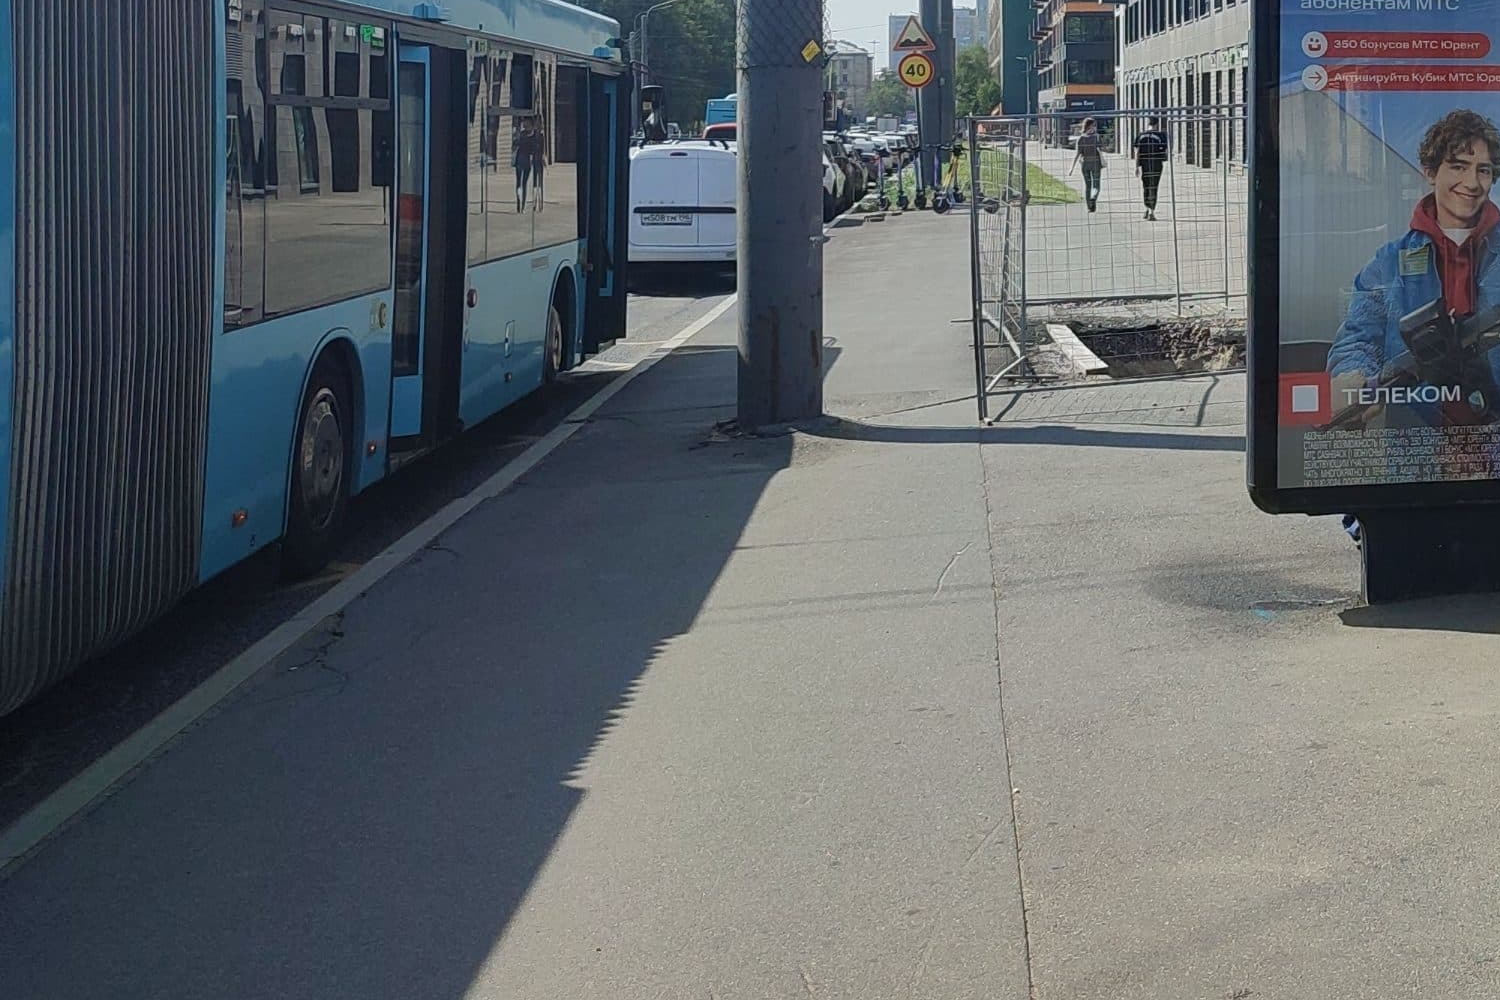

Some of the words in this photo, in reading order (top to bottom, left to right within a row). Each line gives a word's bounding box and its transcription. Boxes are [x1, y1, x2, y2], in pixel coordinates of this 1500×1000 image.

[1333, 40, 1358, 49] 350
[1360, 40, 1410, 51] бонусов
[1412, 40, 1438, 50] МТС
[1441, 40, 1481, 51] Юрент
[905, 63, 926, 77] 40
[1411, 73, 1447, 83] Кубик
[1449, 73, 1475, 82] МТС
[1341, 385, 1461, 407] ТЕЛЕКОМ
